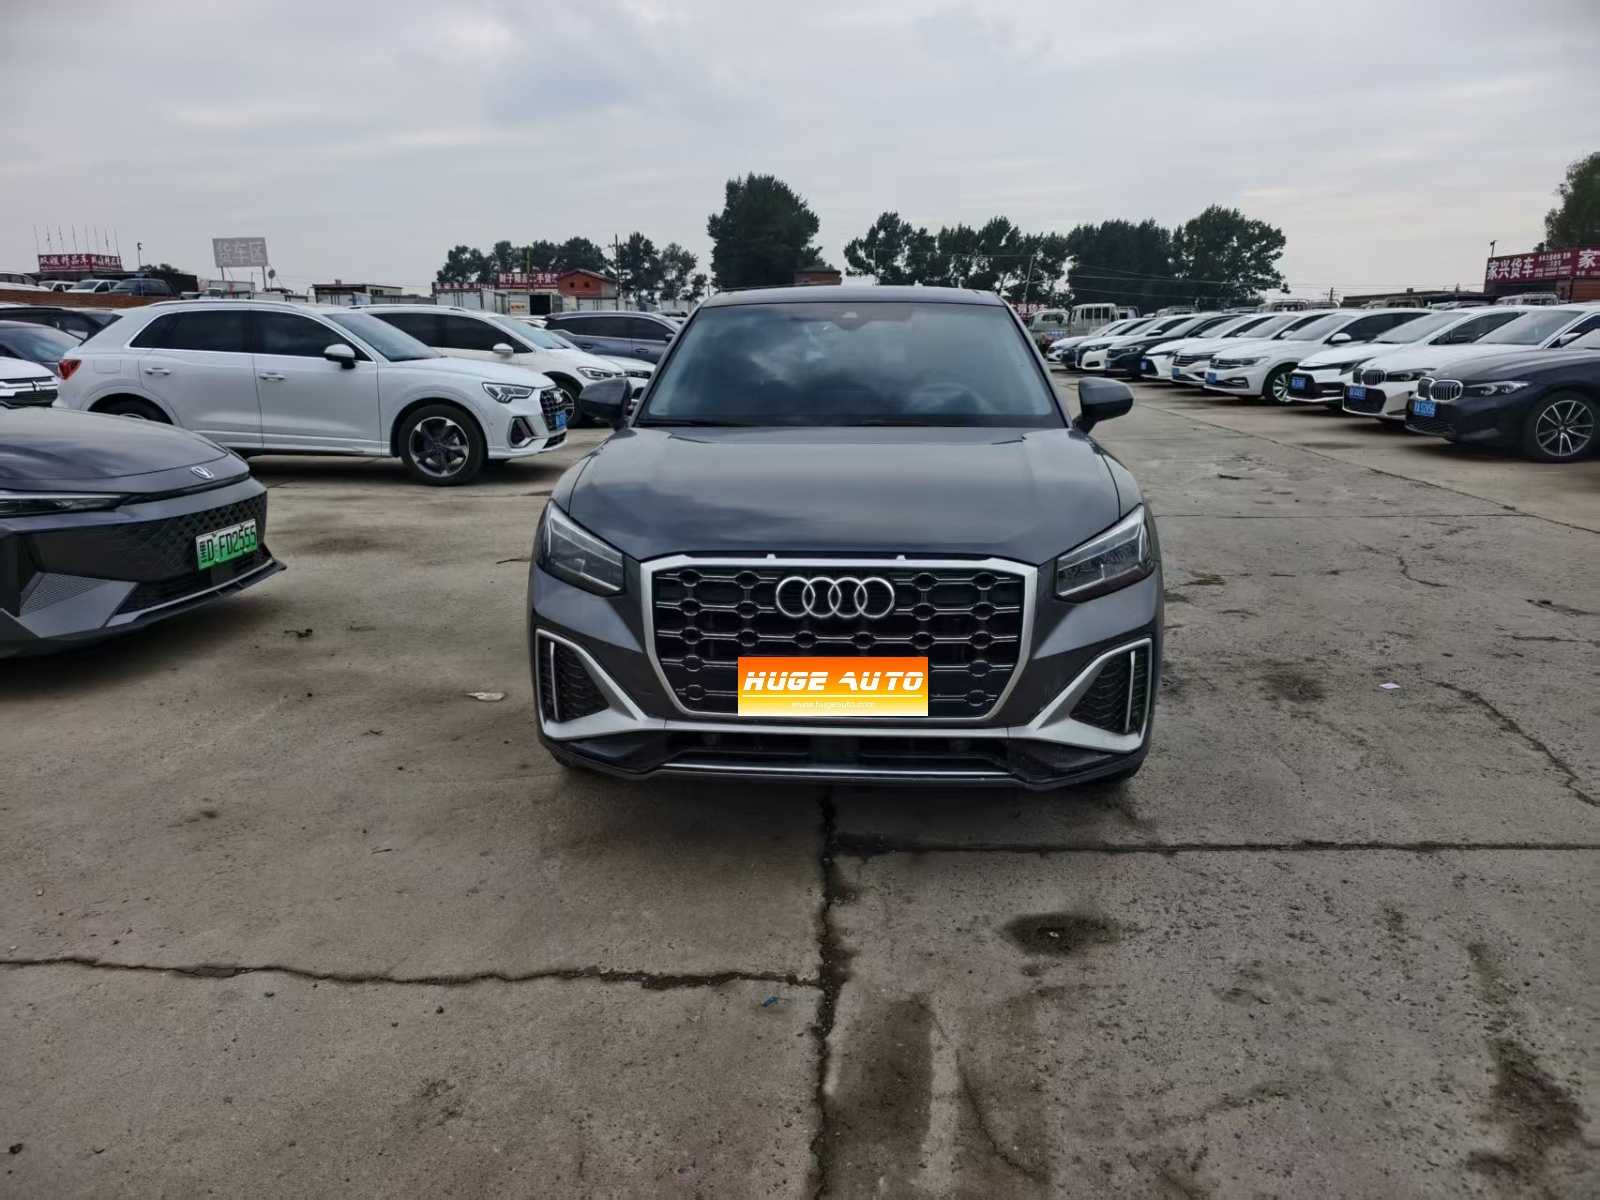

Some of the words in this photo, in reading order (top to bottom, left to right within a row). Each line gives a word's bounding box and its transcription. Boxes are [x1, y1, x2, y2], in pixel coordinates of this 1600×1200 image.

[217, 240, 265, 265] 货车区
[1578, 249, 1596, 268] 家
[1487, 257, 1535, 280] 家兴货车
